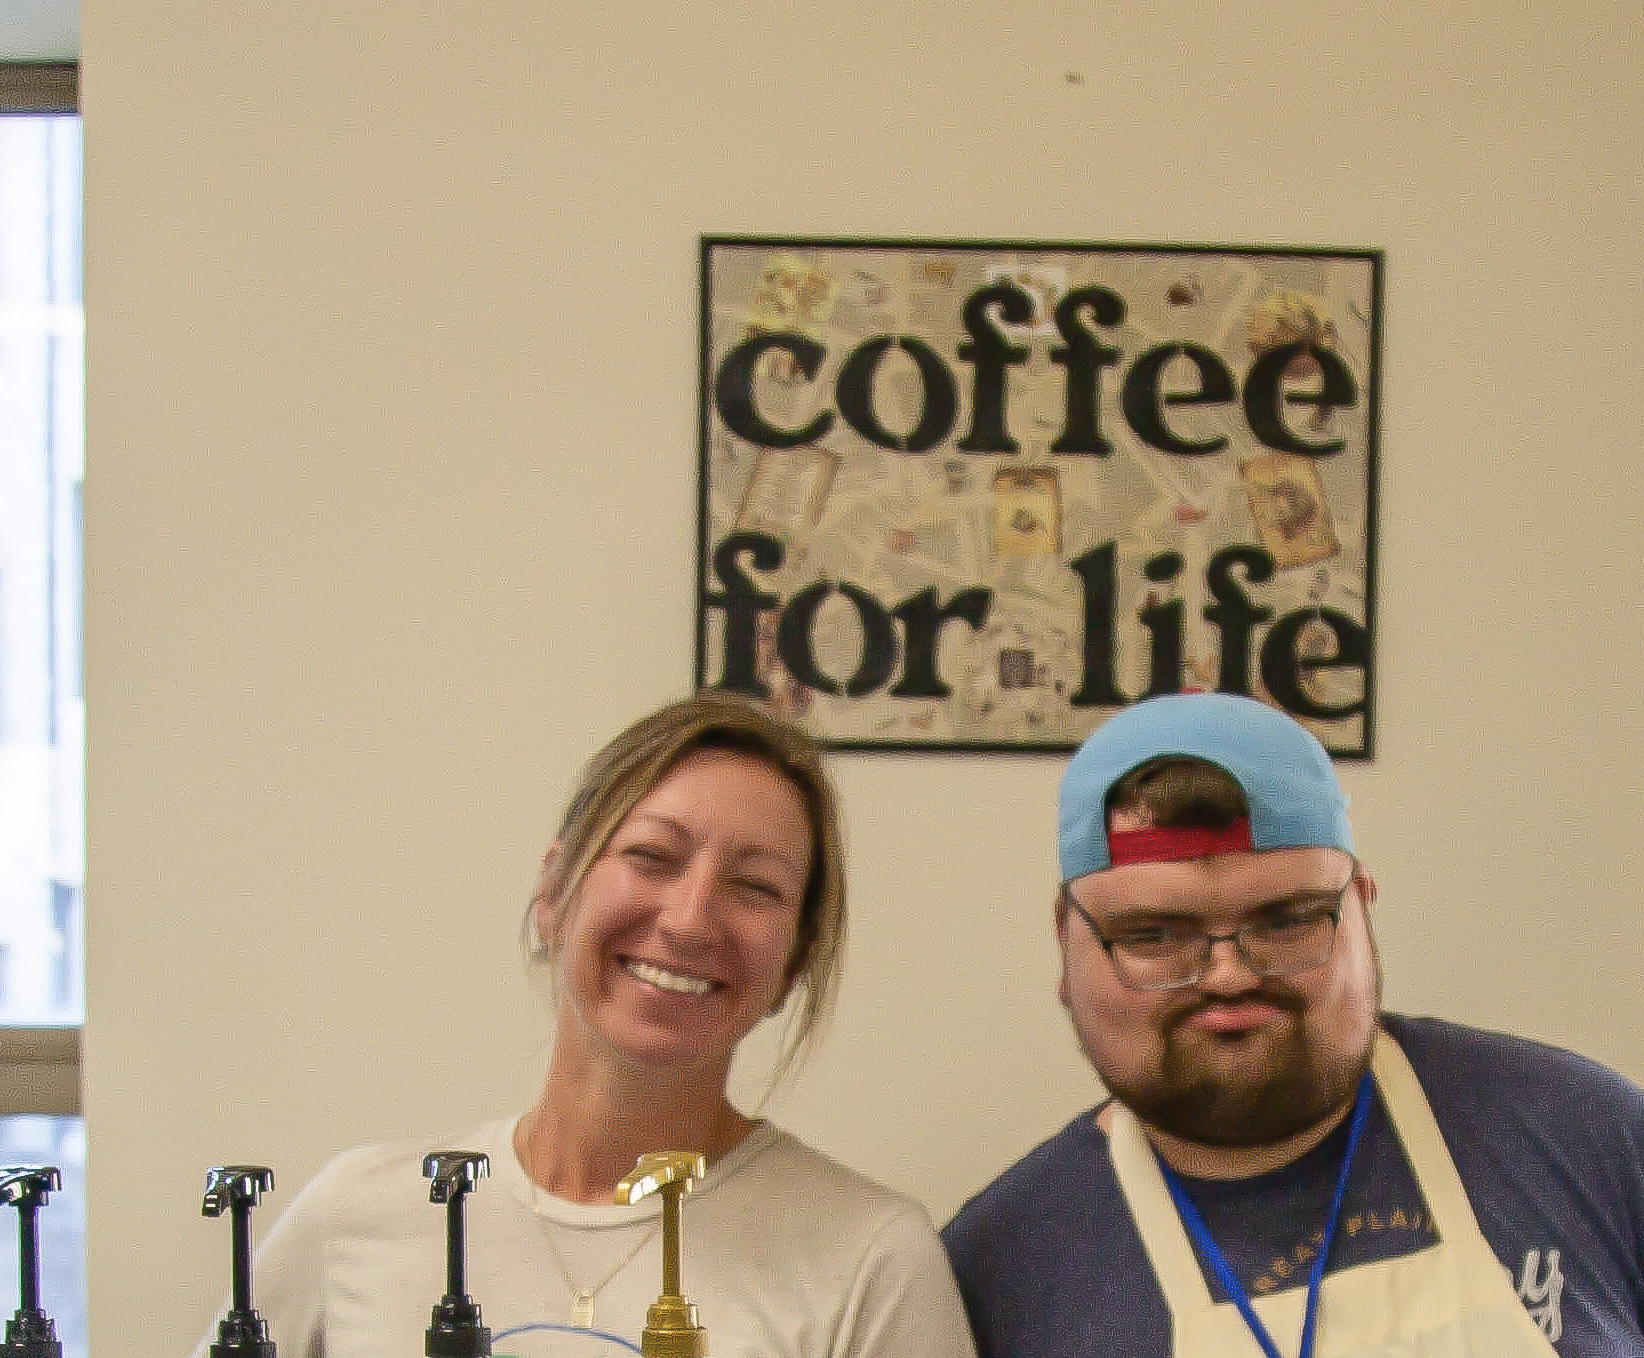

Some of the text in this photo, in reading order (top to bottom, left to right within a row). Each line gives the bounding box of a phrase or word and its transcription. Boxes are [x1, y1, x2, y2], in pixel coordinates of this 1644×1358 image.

[714, 280, 1358, 456] coffee
[703, 533, 1368, 718] for life
